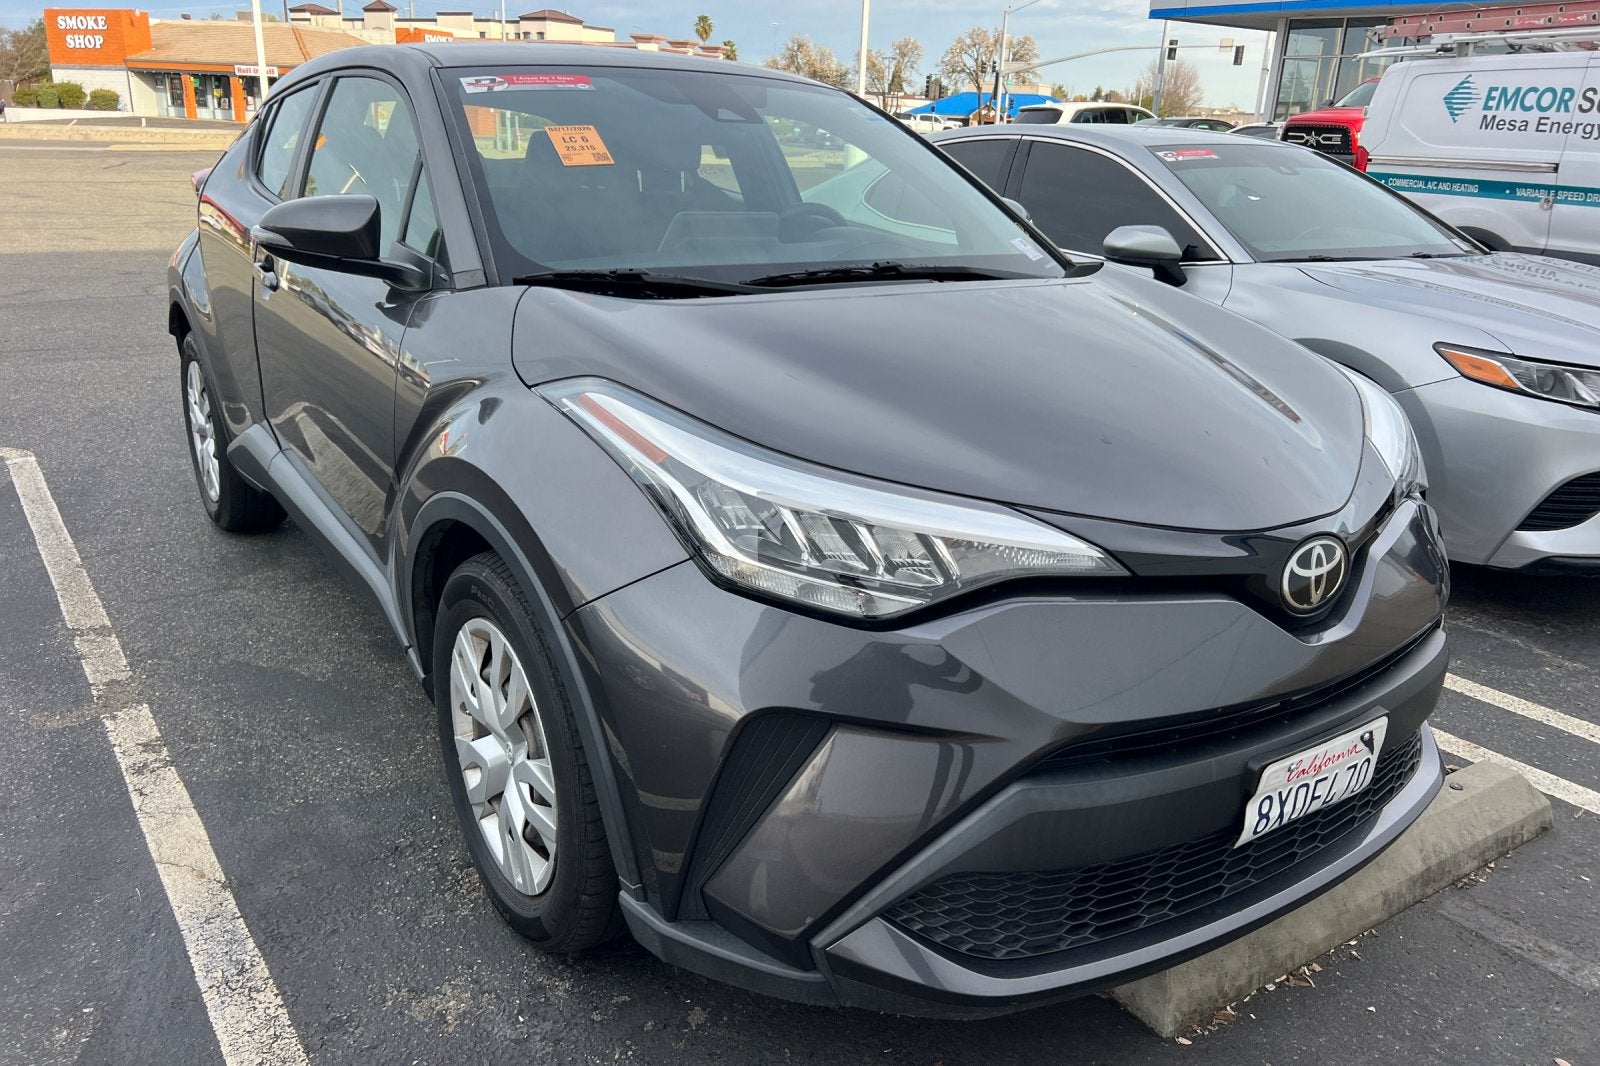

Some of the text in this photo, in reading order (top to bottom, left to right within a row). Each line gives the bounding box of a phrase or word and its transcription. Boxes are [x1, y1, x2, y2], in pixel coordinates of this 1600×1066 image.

[57, 15, 108, 30] SMOKE
[65, 34, 104, 49] SHOP
[1482, 86, 1576, 113] EMCOR
[1479, 114, 1529, 132] Mesa
[561, 136, 577, 144] LC
[1388, 178, 1426, 189] COMMERCIAL
[1438, 183, 1452, 191] AND
[1452, 183, 1479, 193] HEATING
[1516, 187, 1556, 198] VARIABLE
[1556, 190, 1586, 201] SPEED
[1287, 743, 1364, 783] California
